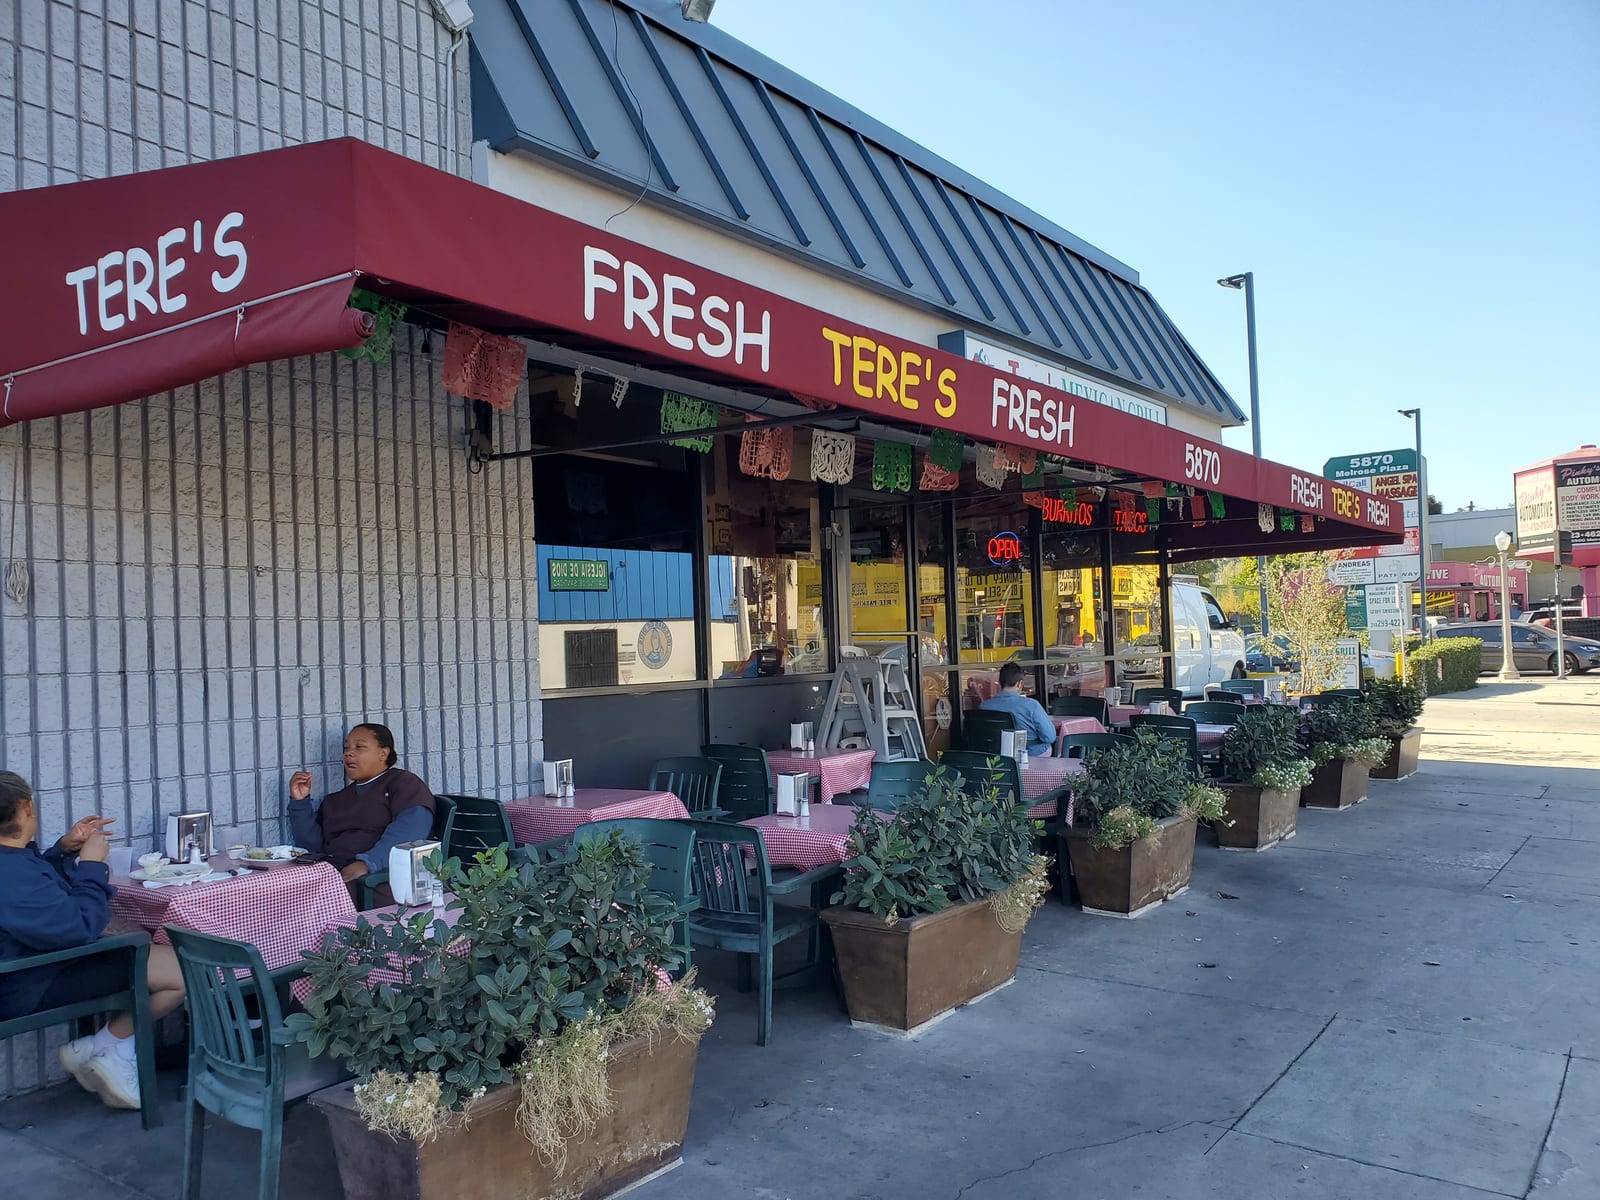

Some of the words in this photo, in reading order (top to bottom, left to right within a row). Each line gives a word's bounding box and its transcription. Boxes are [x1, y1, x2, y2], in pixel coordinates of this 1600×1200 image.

[65, 211, 249, 336] TERE'S
[582, 245, 772, 374] FRESH
[822, 327, 958, 419] TERE'S
[992, 378, 1075, 448] FRESH
[1184, 442, 1221, 486] 5870
[1336, 467, 1377, 478] Melrose
[1380, 464, 1409, 473] Plaza
[1350, 454, 1394, 468] 5870
[1290, 474, 1324, 510] FRESH
[1376, 475, 1401, 487] ANGEL
[1042, 497, 1093, 527] BURRITOS
[1331, 487, 1360, 520] TERE'S
[1366, 498, 1390, 527] FRESH
[1519, 501, 1553, 522] AUTOMOTIVE
[1114, 509, 1148, 534] TACOS
[987, 539, 1020, 560] OPEN
[1338, 560, 1371, 568] ANDREAS
[1335, 647, 1356, 656] GRILL
